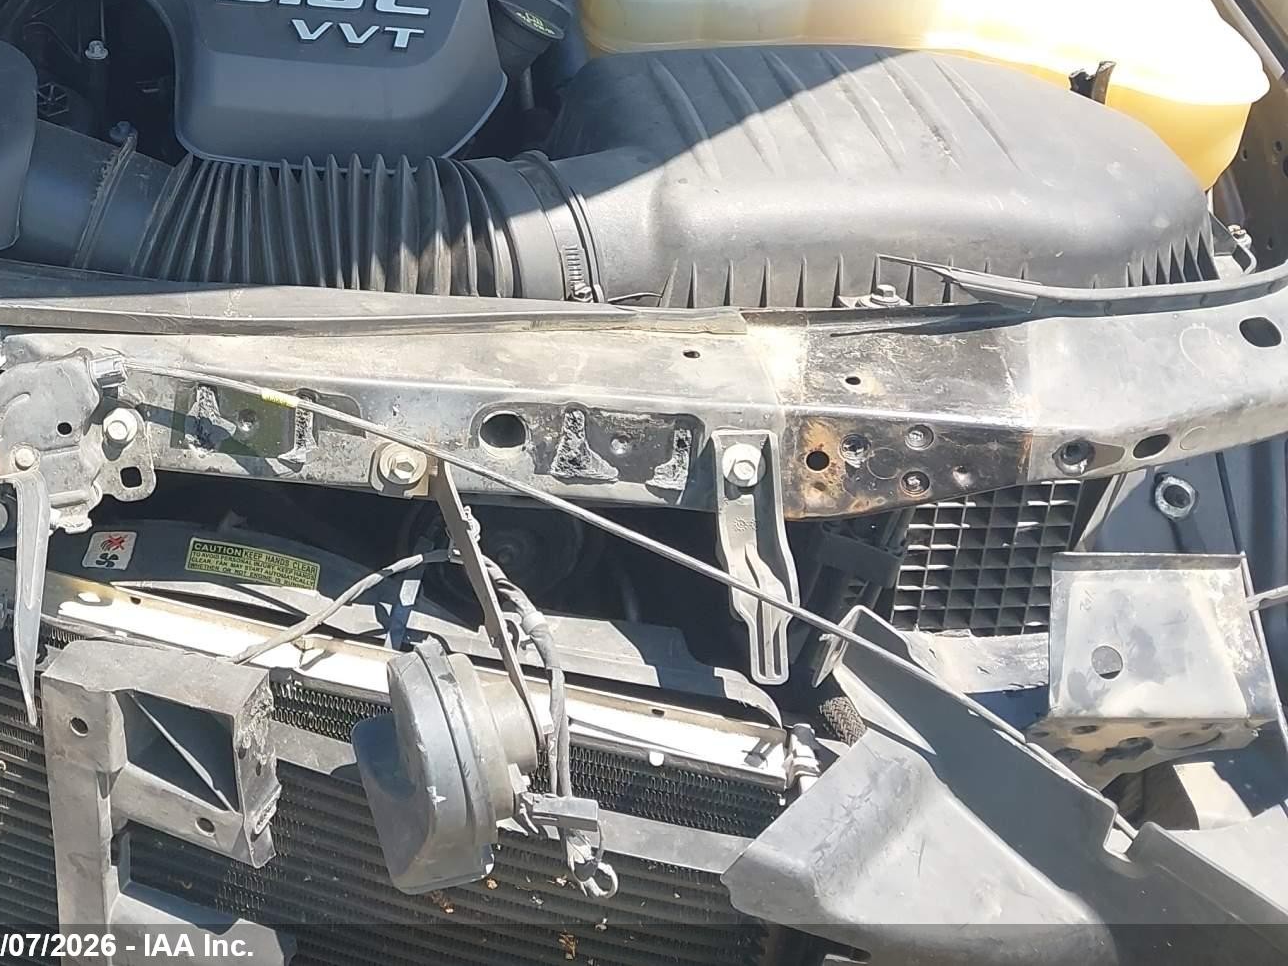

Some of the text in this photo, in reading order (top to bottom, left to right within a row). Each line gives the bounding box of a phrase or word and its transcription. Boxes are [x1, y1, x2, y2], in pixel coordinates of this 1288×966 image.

[291, 19, 426, 49] VVT
[194, 543, 316, 573] CAUTION KEEP HANDS CLEAR
[220, 555, 252, 565] PERSONAL
[244, 564, 264, 573] START
[264, 569, 315, 586] AUTOMATICALLY
